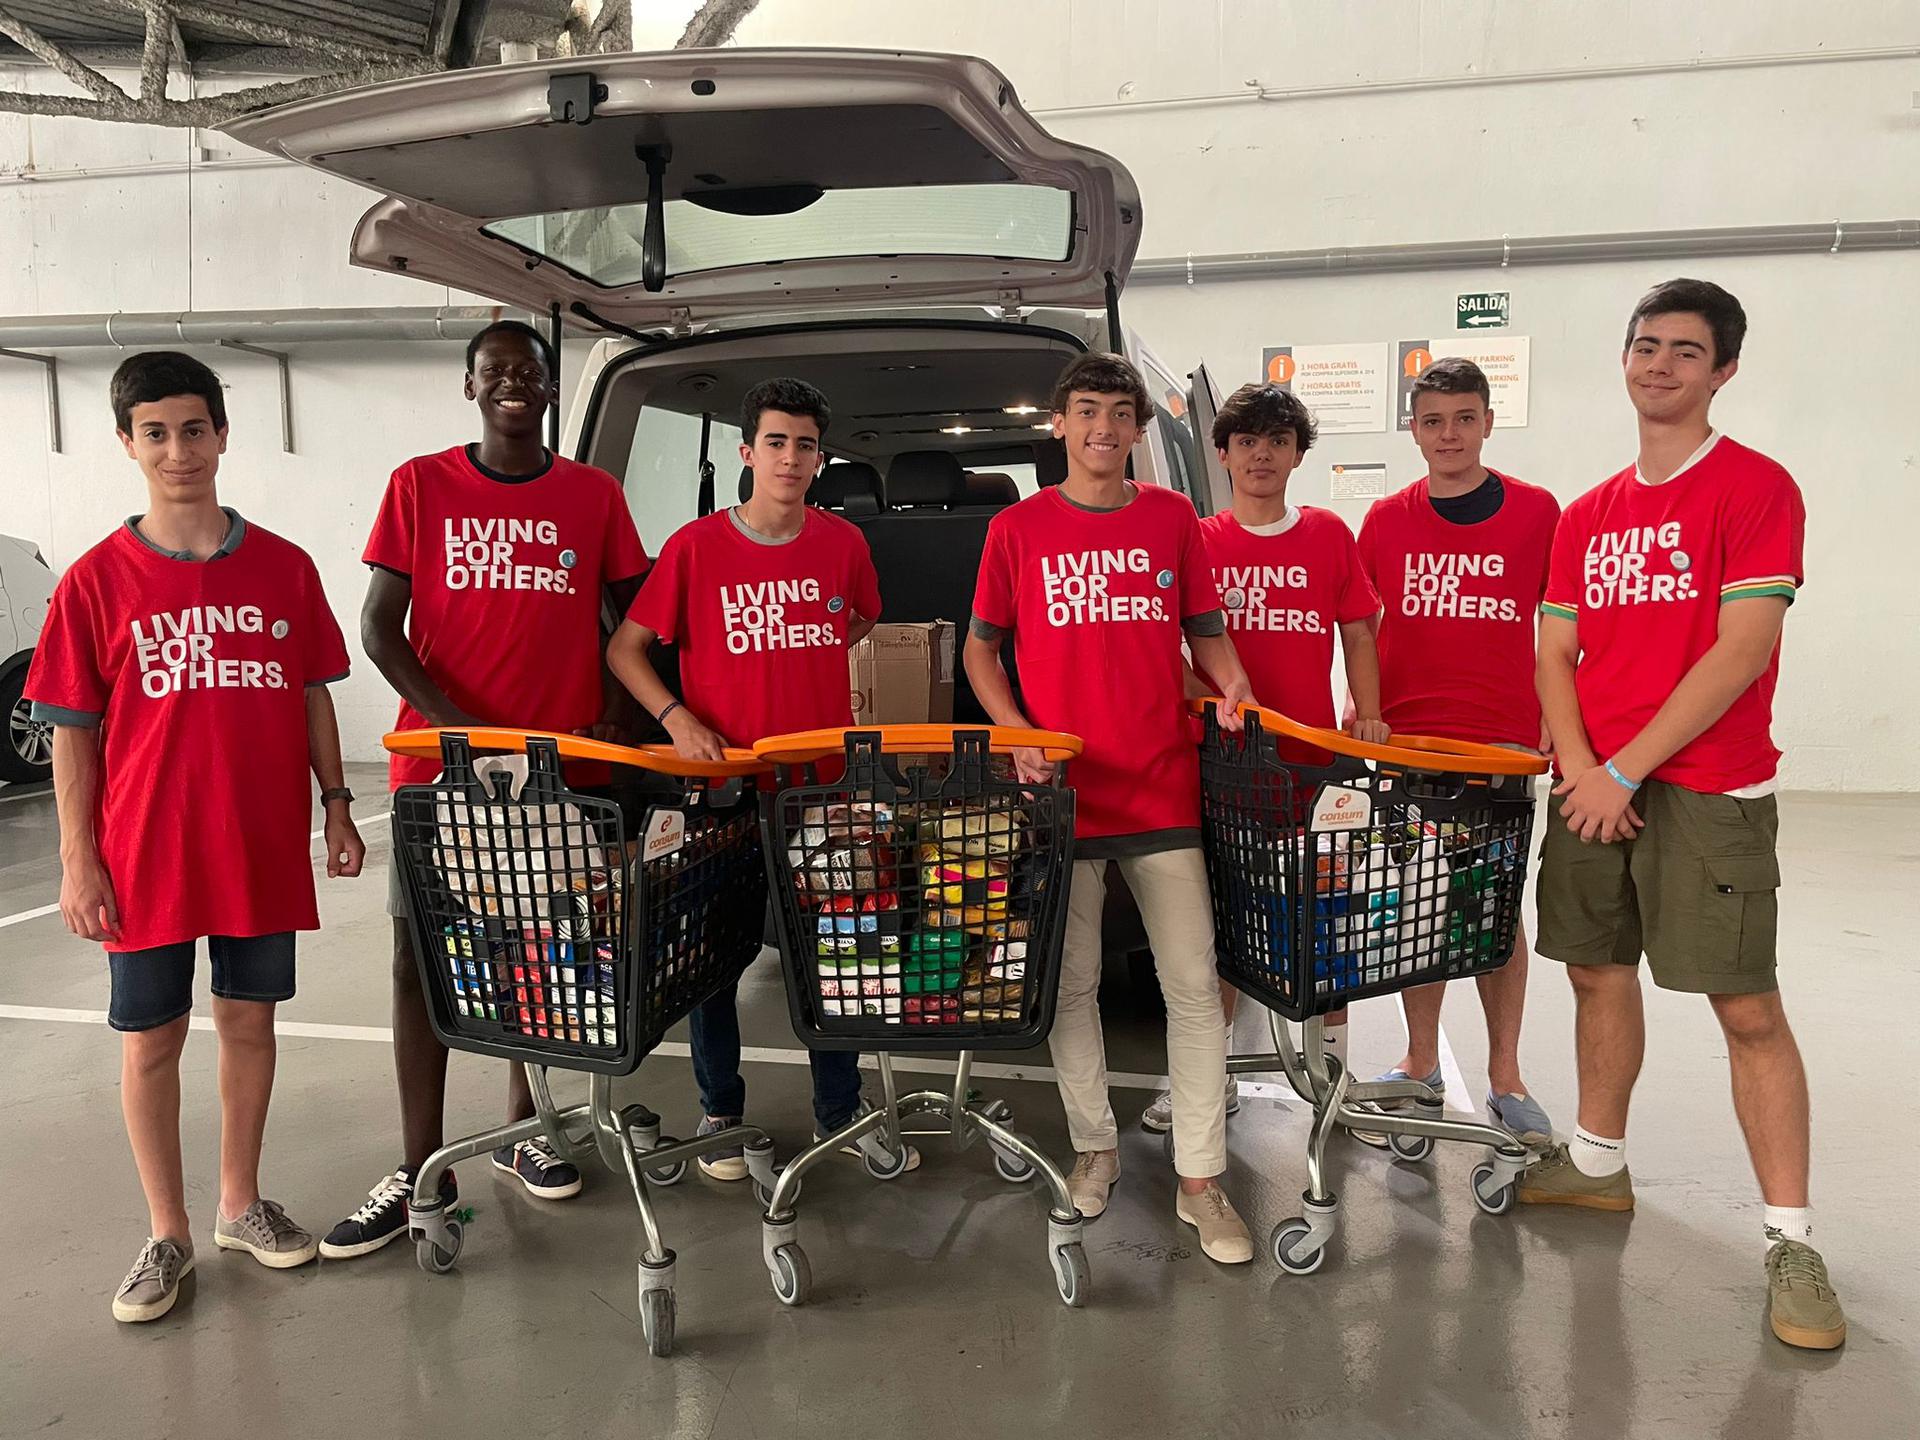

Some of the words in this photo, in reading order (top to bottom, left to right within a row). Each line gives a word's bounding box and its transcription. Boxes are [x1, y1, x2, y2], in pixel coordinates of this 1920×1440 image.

[1459, 296, 1507, 311] SALIDA
[1306, 362, 1329, 370] HORA
[1331, 361, 1358, 369] GRATIS
[1480, 354, 1515, 362] PARKING
[1306, 382, 1333, 390] HORAS
[1334, 380, 1361, 389] GRATIS
[1488, 374, 1519, 382] ARKING
[445, 518, 558, 545] LIVING
[1585, 521, 1681, 559] LIVING
[445, 541, 514, 566] FOR
[1041, 548, 1150, 580] LIVING
[1405, 553, 1504, 577] LIVING
[446, 565, 576, 594] OTHERS.
[1584, 552, 1647, 585] FOR
[720, 578, 820, 609] LIVING
[1044, 574, 1109, 604] FOR
[1403, 574, 1460, 596] FOR
[1585, 572, 1699, 609] OTHERS.
[723, 604, 785, 632] FOR
[1047, 596, 1169, 627] OTHERS.
[1221, 608, 1327, 634] THERS.
[1402, 594, 1521, 622] OTHERS.
[131, 605, 263, 646] LIVING
[726, 622, 841, 654] OTHERS.
[136, 634, 215, 672] FOR
[142, 659, 288, 699] OTHERS.
[1319, 811, 1363, 821] consum
[649, 831, 680, 849] consum
